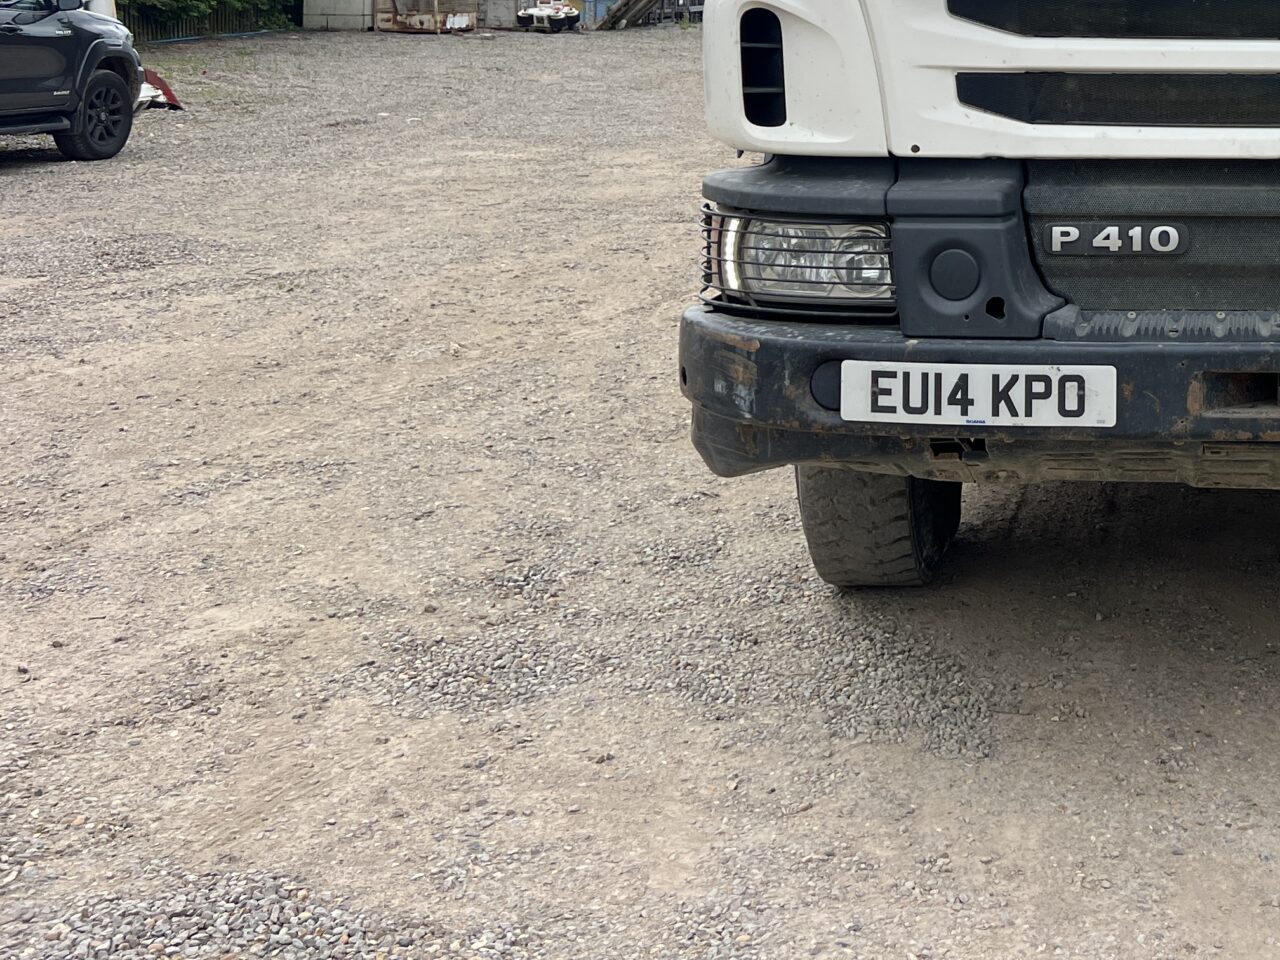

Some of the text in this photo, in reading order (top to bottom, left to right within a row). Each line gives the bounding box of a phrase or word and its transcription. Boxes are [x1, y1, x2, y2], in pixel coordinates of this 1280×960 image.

[1051, 225, 1180, 252] P 410
[870, 369, 1086, 418] EU14 KPO
